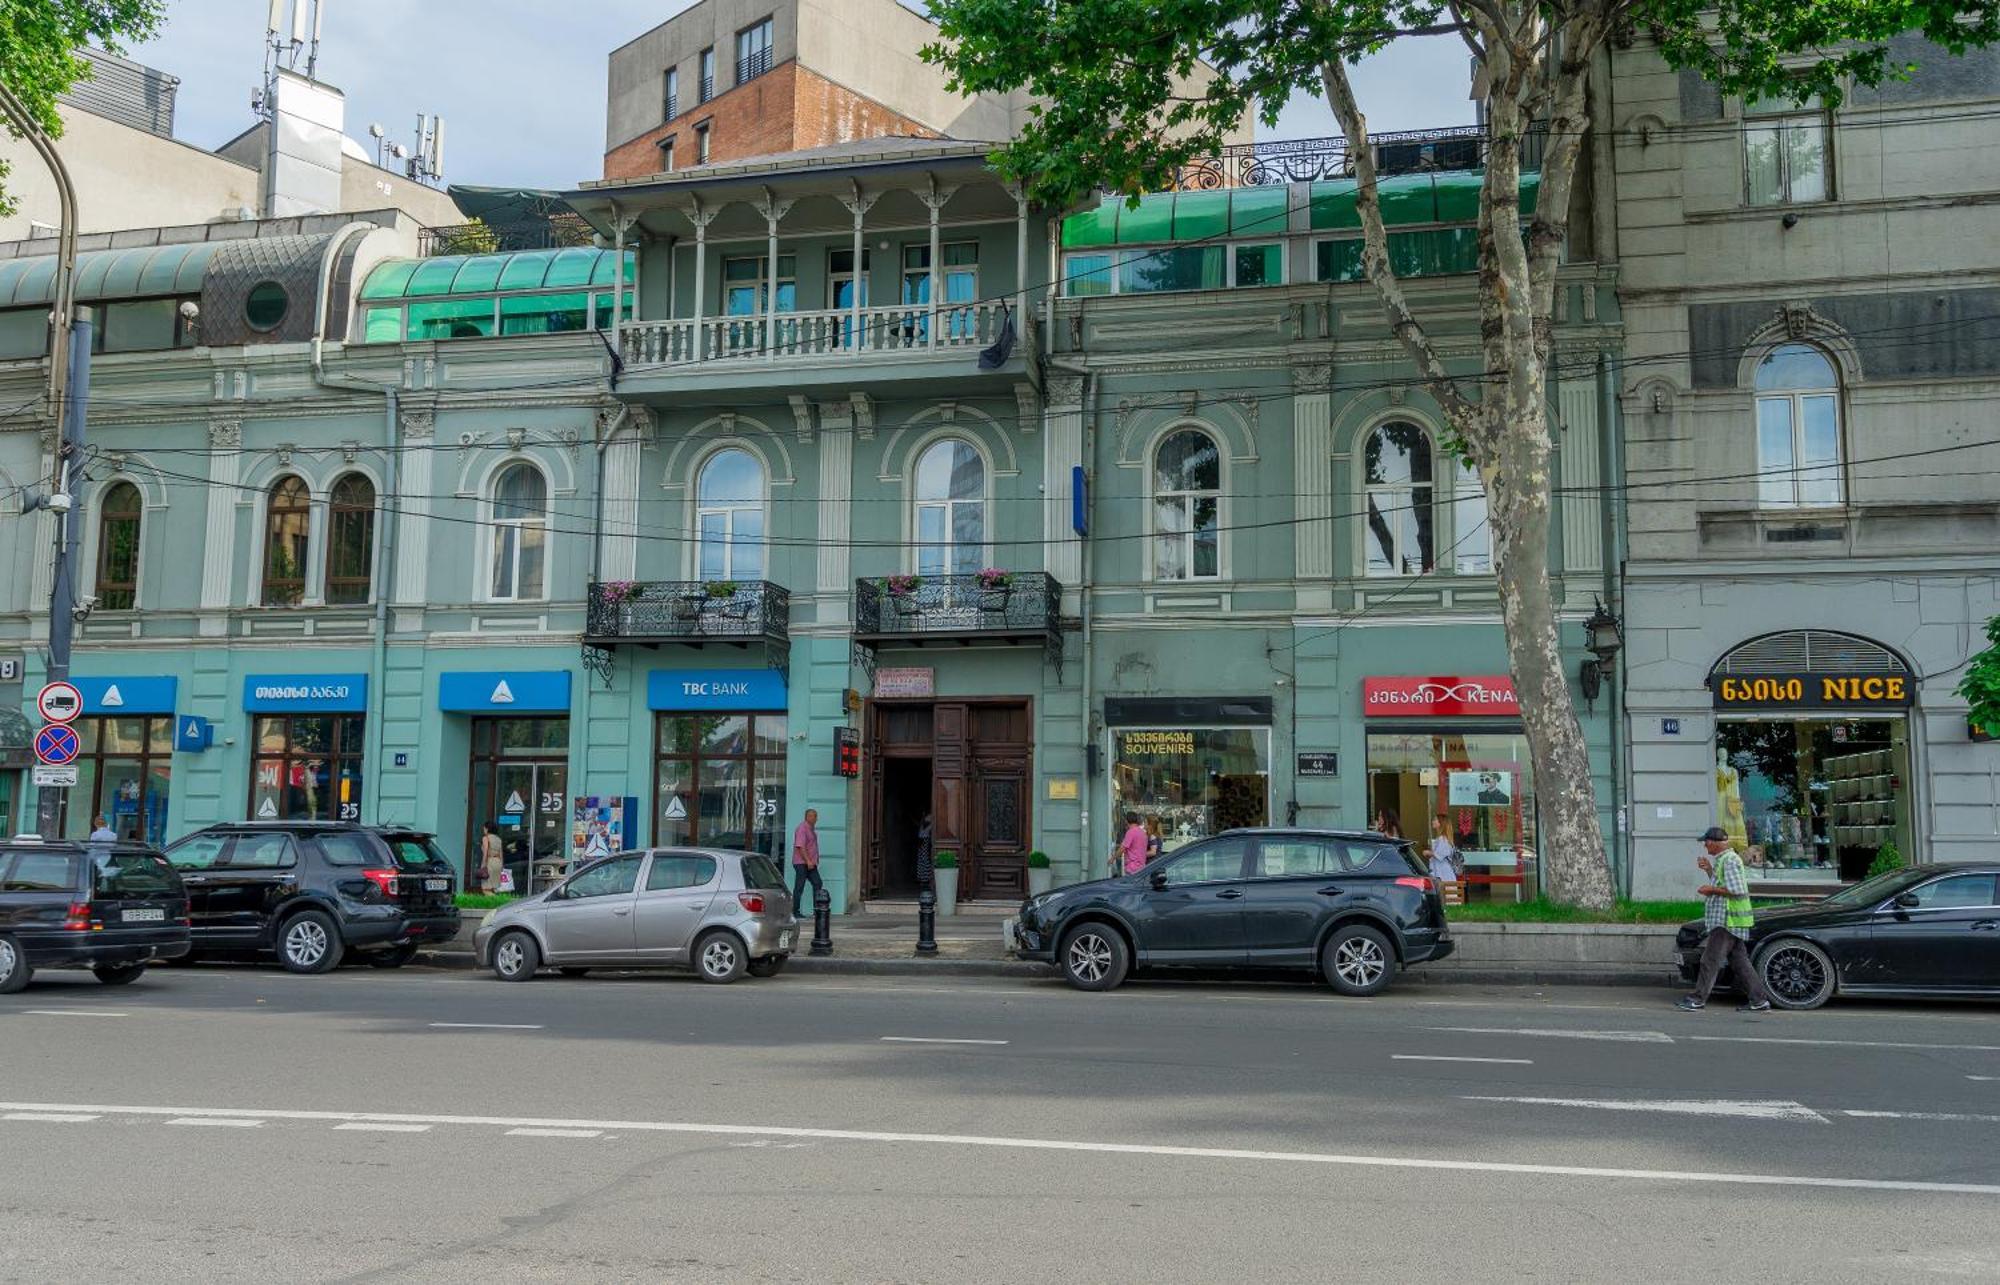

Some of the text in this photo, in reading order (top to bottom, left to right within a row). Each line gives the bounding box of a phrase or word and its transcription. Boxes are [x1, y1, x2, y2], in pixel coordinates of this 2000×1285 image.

[310, 686, 349, 699] ბანკი
[682, 682, 750, 696] TBC BANK
[1722, 677, 1906, 701] ნაისი NICE
[1370, 690, 1518, 704] კენარი KENA
[1126, 743, 1194, 754] SOUVENIRS
[1312, 760, 1324, 769] 44
[541, 792, 563, 811] 25
[757, 799, 777, 816] 25
[341, 803, 358, 819] 25
